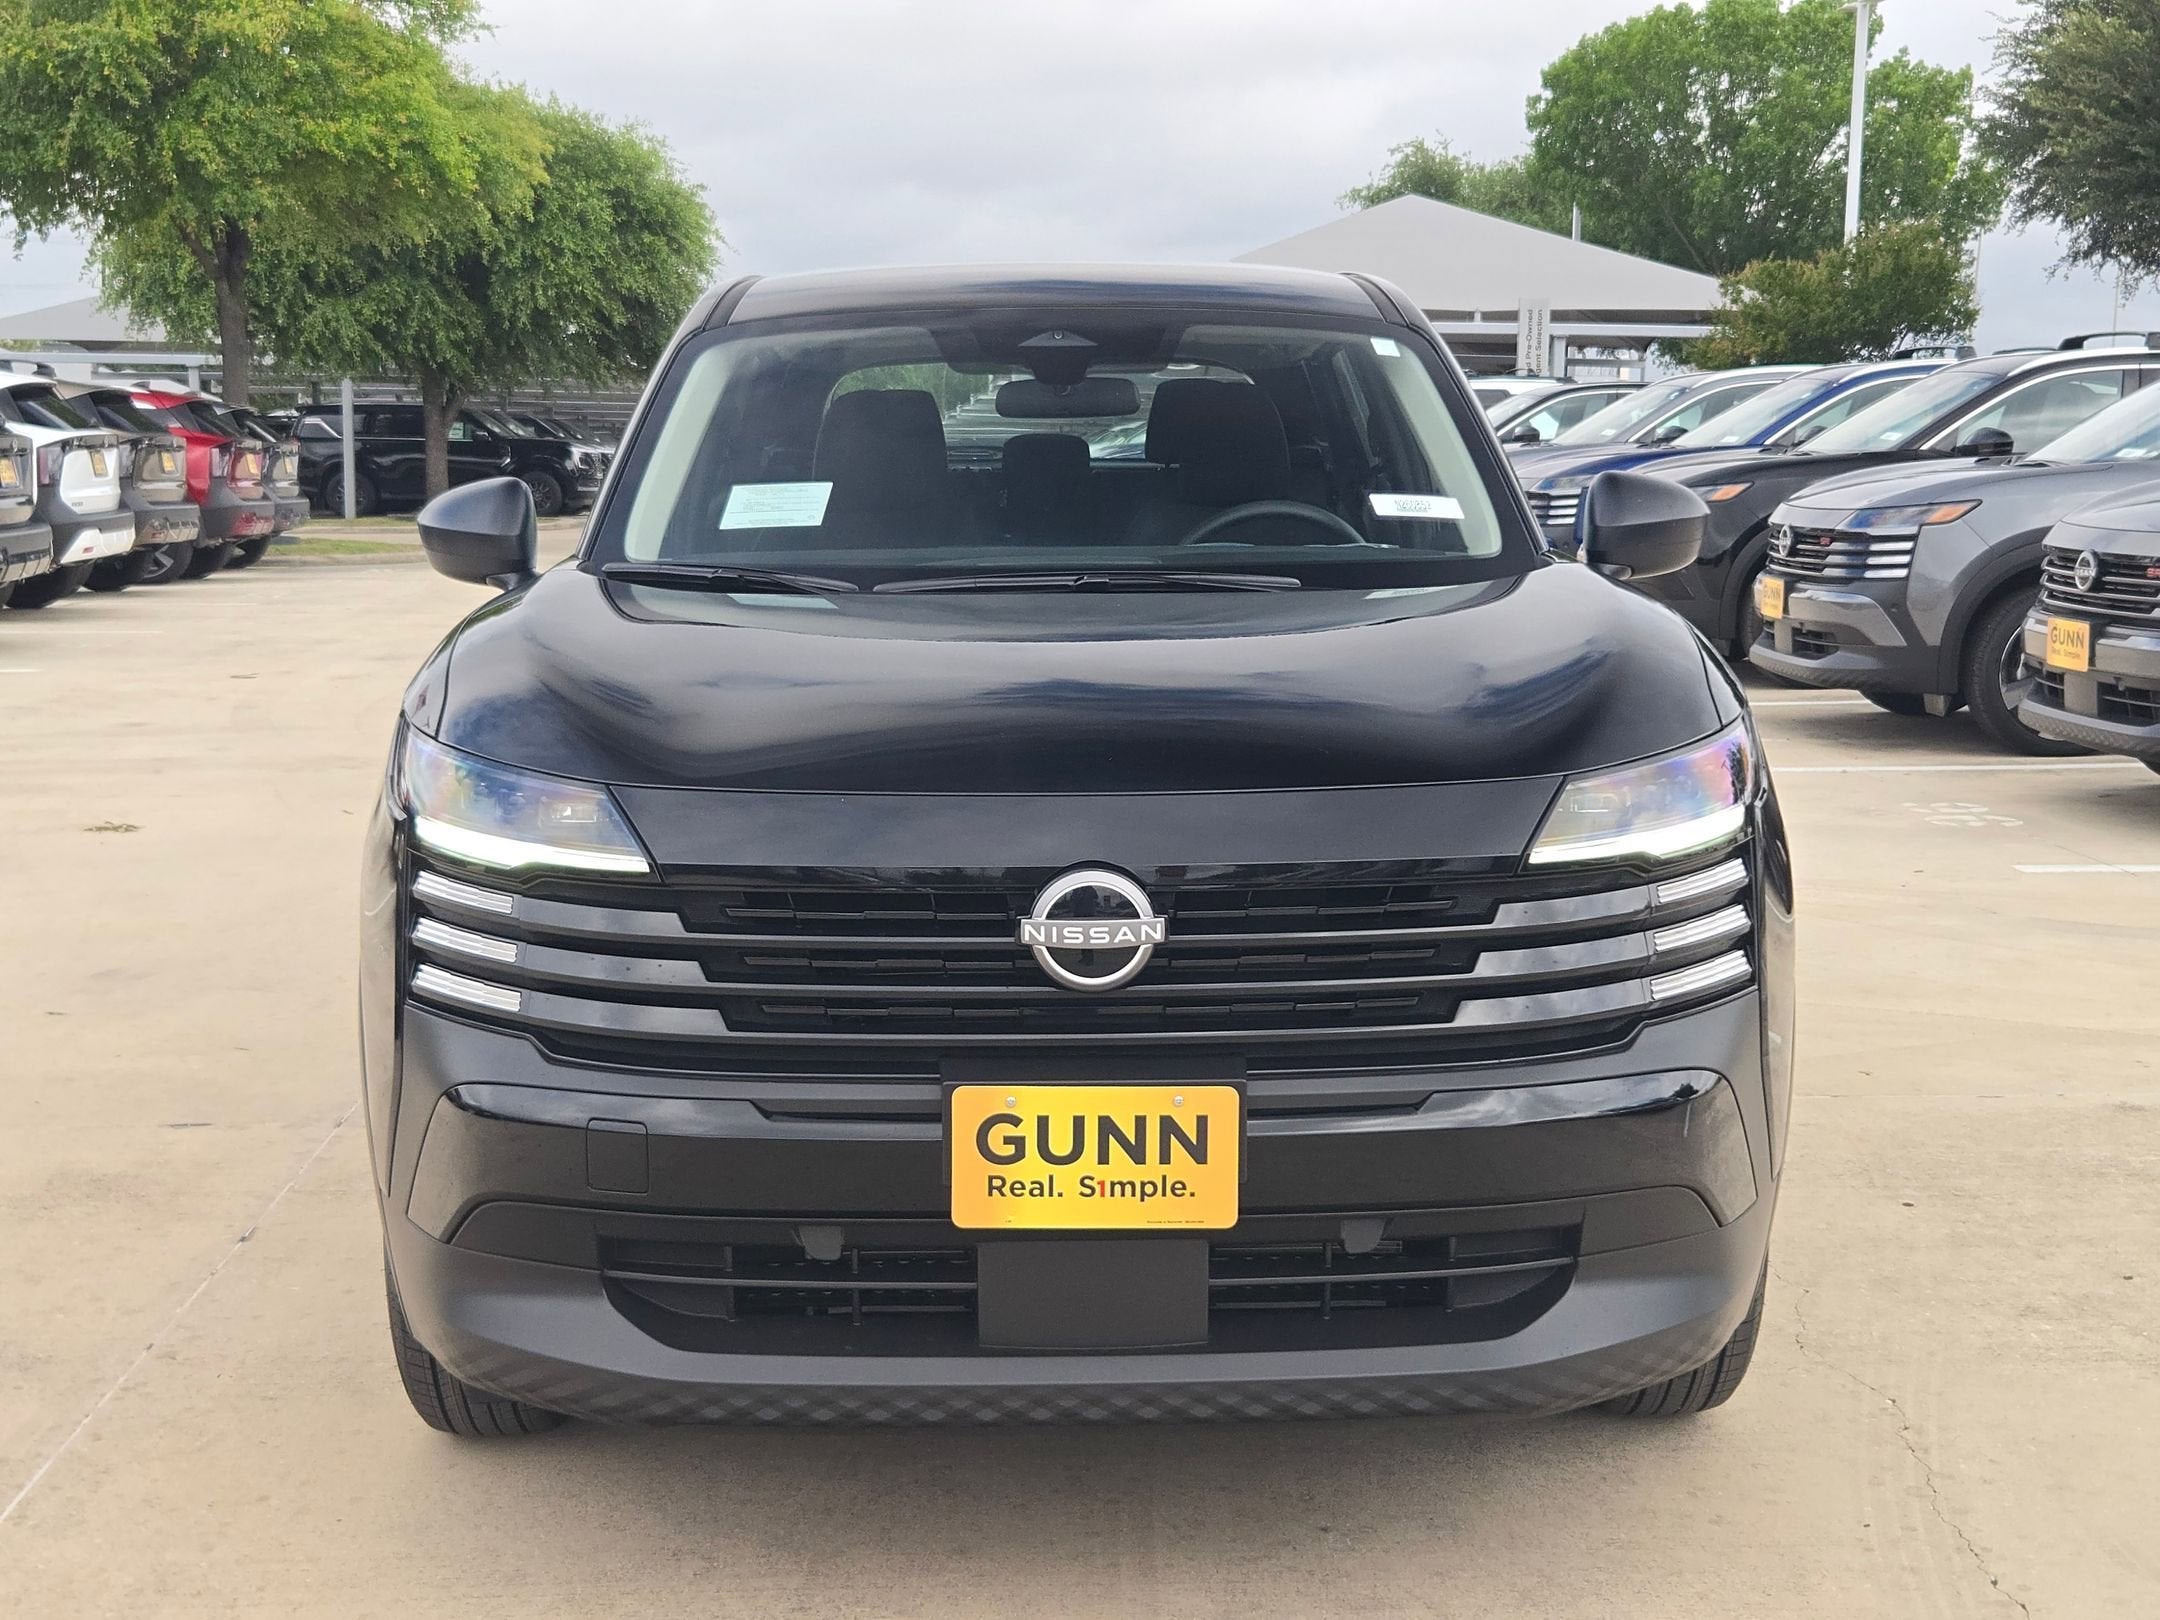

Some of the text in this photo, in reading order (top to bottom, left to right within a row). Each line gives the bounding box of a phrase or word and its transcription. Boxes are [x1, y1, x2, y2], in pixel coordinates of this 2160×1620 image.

[1525, 309, 1533, 360] Pre-Owned
[1535, 309, 1543, 351] Selection
[2050, 626, 2085, 649] GUNN
[1023, 922, 1162, 944] NISSAN
[975, 1112, 1209, 1166] GUNN
[987, 1174, 1064, 1198] Real.
